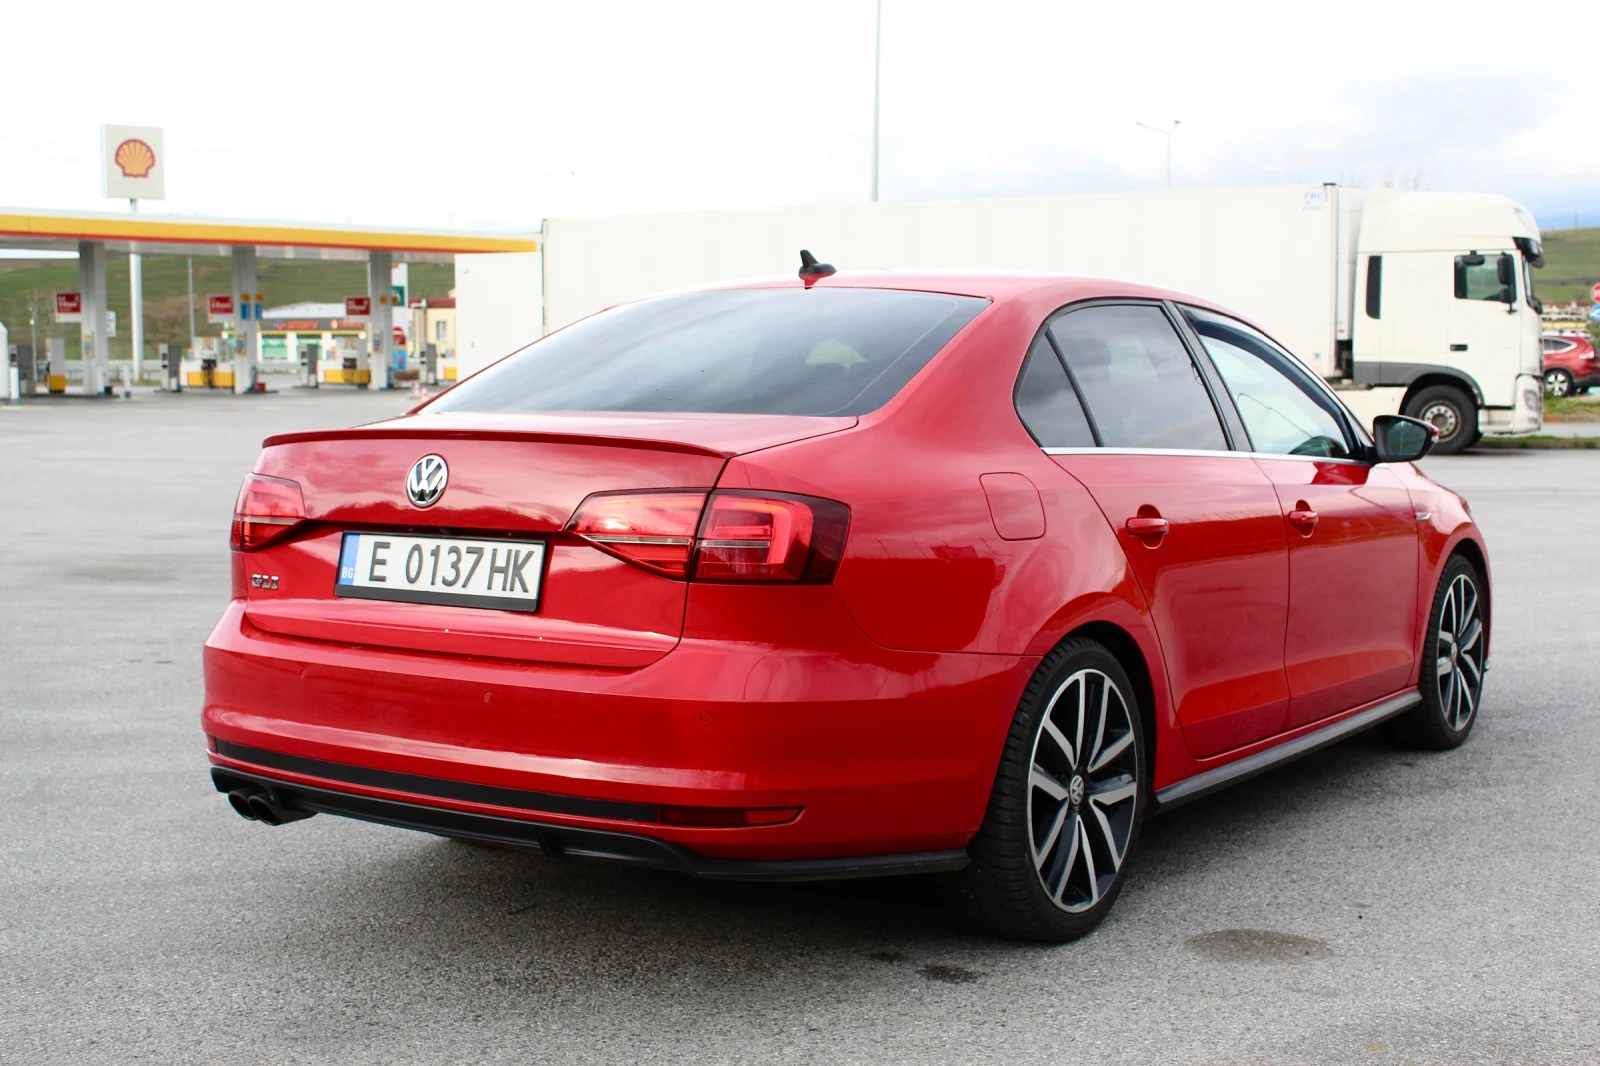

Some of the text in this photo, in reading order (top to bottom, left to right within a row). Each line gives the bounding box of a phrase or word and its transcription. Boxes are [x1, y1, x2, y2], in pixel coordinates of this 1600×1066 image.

[408, 455, 448, 506] VW
[251, 573, 279, 590] GLI
[341, 567, 354, 580] BG
[369, 541, 535, 593] E 0137 HK
